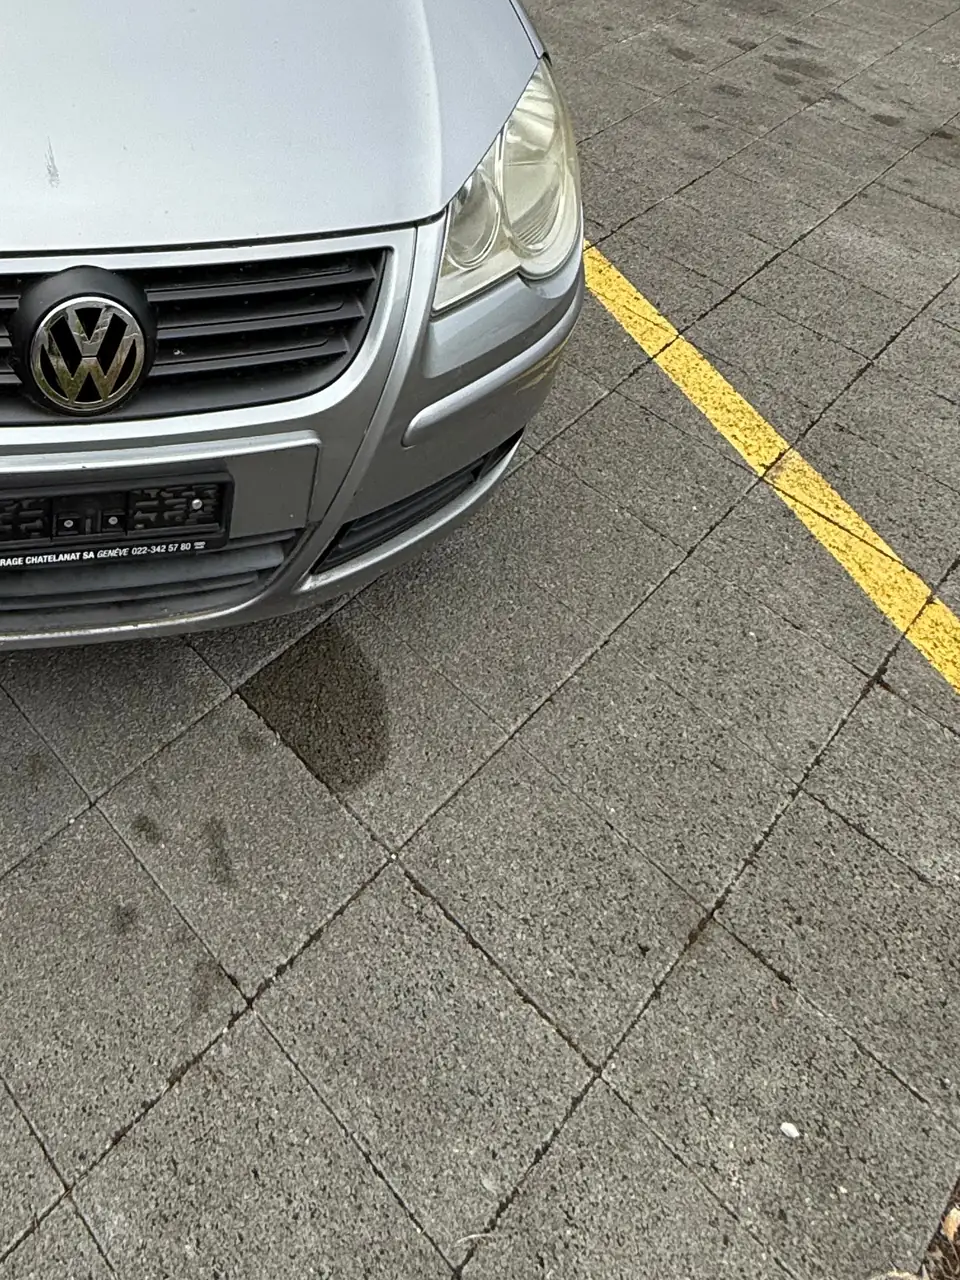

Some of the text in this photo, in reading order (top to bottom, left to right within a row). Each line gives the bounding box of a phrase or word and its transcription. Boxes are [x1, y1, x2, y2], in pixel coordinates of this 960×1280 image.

[25, 552, 81, 565] CHATELANAT
[82, 551, 95, 560] SA
[131, 544, 166, 556] 022-342
[167, 543, 179, 553] 57
[180, 542, 192, 551] 80
